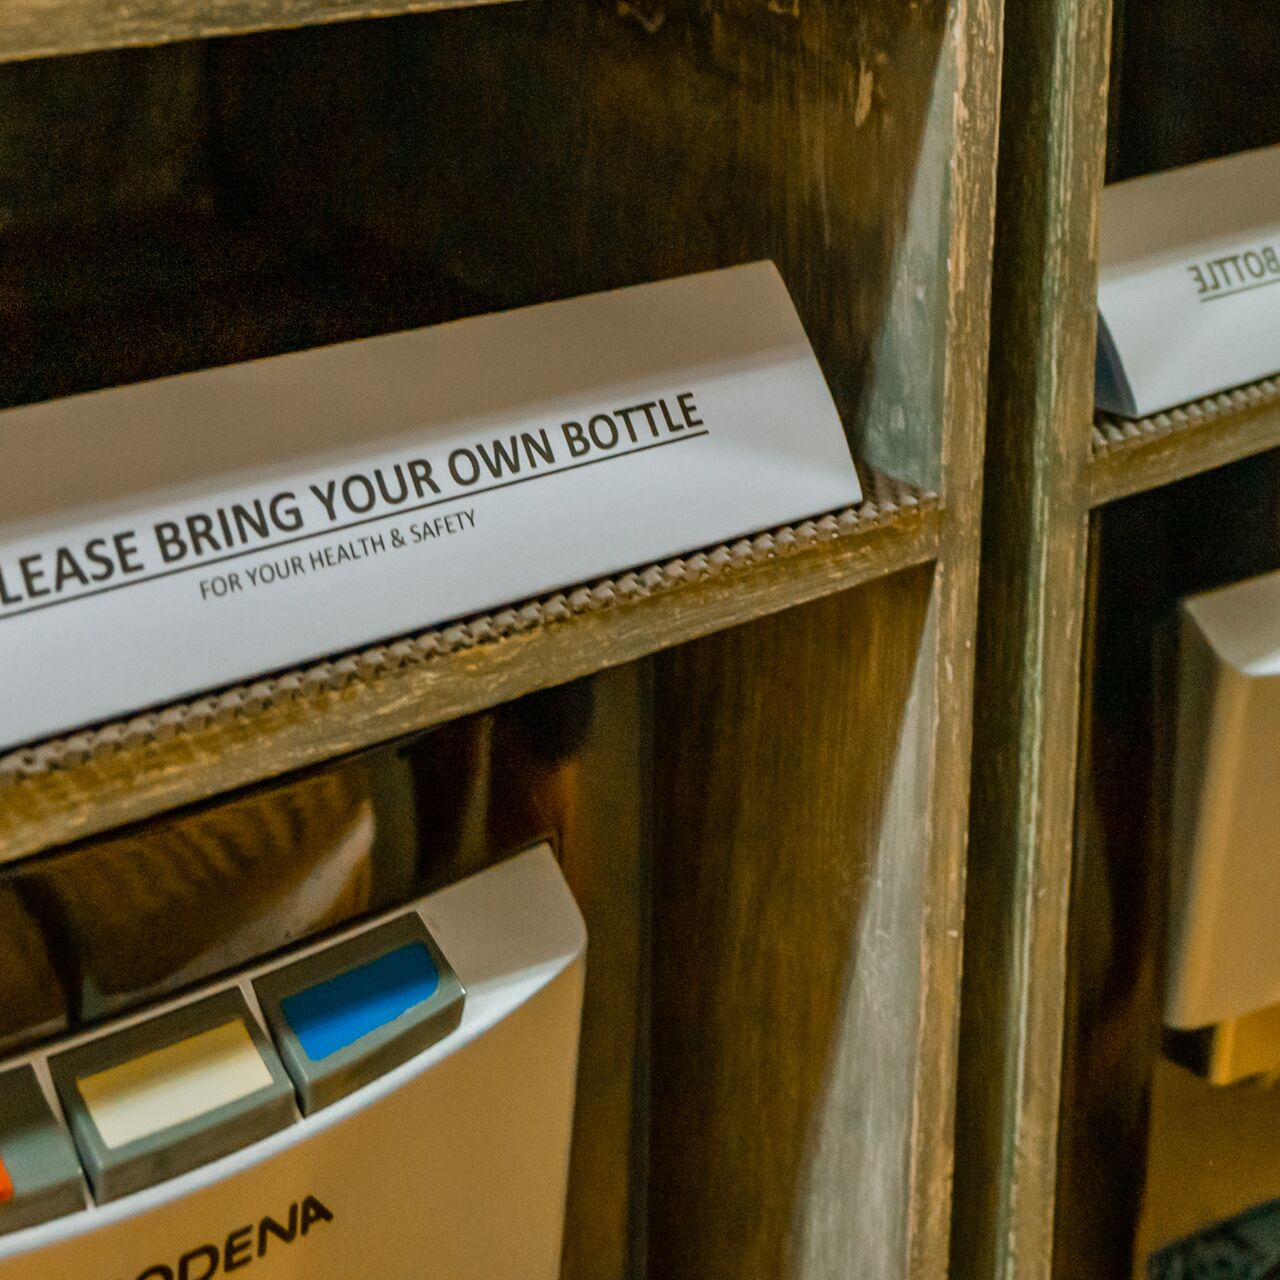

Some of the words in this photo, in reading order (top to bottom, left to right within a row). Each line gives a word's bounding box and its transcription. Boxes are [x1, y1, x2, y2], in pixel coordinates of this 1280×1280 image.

[154, 491, 304, 564] BRING
[310, 458, 441, 521] YOUR
[447, 428, 556, 487] OWN
[561, 392, 704, 458] BOTTLE
[200, 575, 243, 600] FOR
[245, 557, 306, 588] YOUR
[309, 533, 387, 572] HEALTH
[390, 528, 406, 549] &
[410, 508, 477, 544] SAFETY
